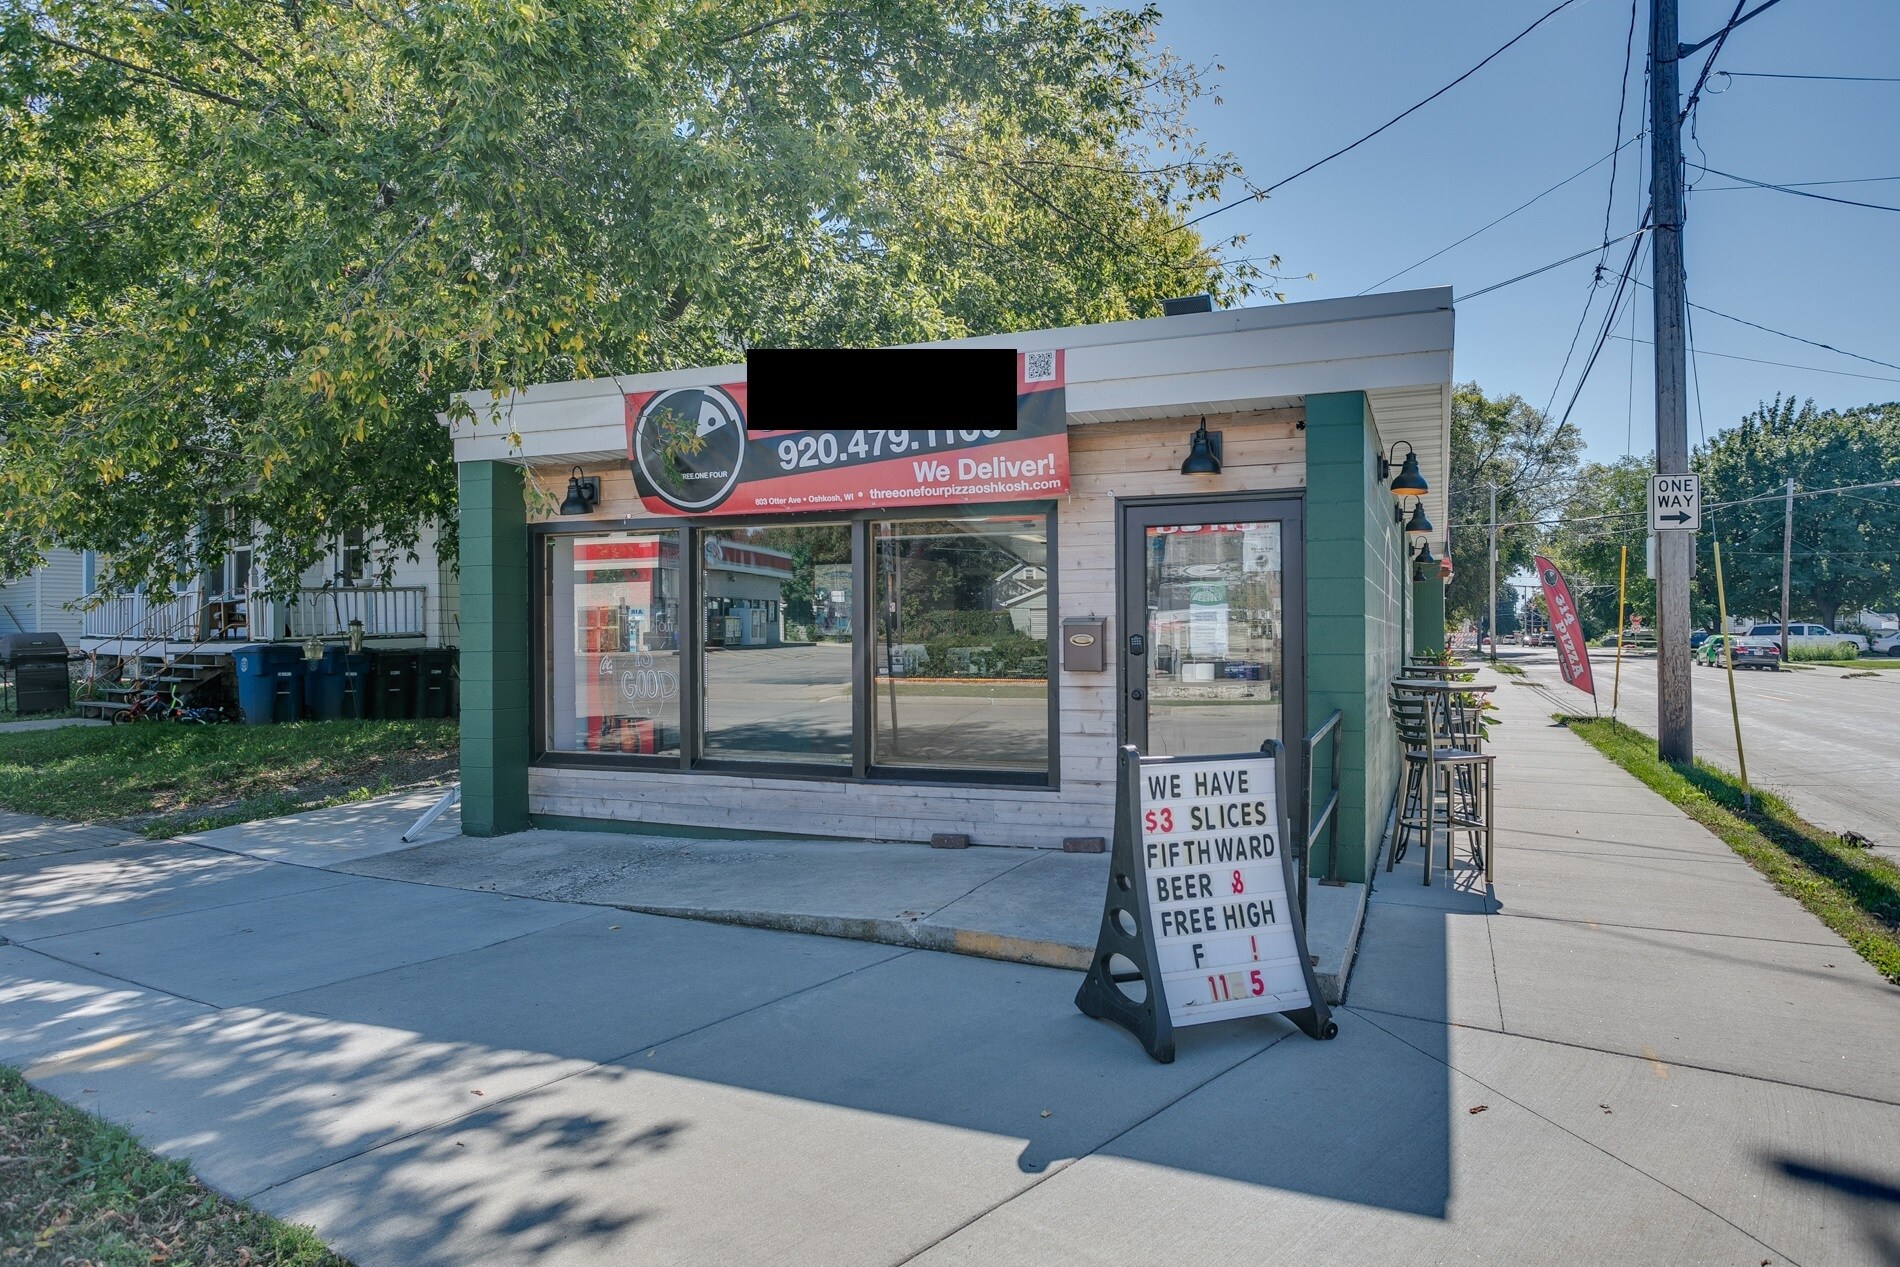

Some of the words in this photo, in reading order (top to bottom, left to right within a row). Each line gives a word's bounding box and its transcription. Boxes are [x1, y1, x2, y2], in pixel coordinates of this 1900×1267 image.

[778, 430, 1002, 471] 920.479.1
[709, 470, 728, 478] FOUR
[912, 461, 951, 482] We
[957, 453, 1056, 481] Deliver!
[755, 498, 768, 506] 803
[769, 497, 787, 505] Otter
[788, 496, 802, 504] Ave
[808, 494, 843, 503] Oshkosh,
[869, 478, 1061, 499] threeonefourpizzaoshkosh.com
[1658, 479, 1693, 492] ONE
[1657, 495, 1694, 508] WAY
[1555, 593, 1575, 627] 314
[1555, 620, 1584, 678] PIZZA
[621, 669, 678, 699] GOOD
[1148, 774, 1182, 800] WE
[1194, 770, 1249, 797] HAVE
[1145, 807, 1174, 833] $3
[1190, 801, 1267, 831] SLICES
[1157, 873, 1213, 902] BEER
[1232, 870, 1245, 894] &
[1161, 906, 1218, 937] FREE
[1223, 900, 1276, 930] HIGH
[1193, 943, 1205, 969] F
[1208, 974, 1230, 1001] 11
[1251, 969, 1265, 996] 5
